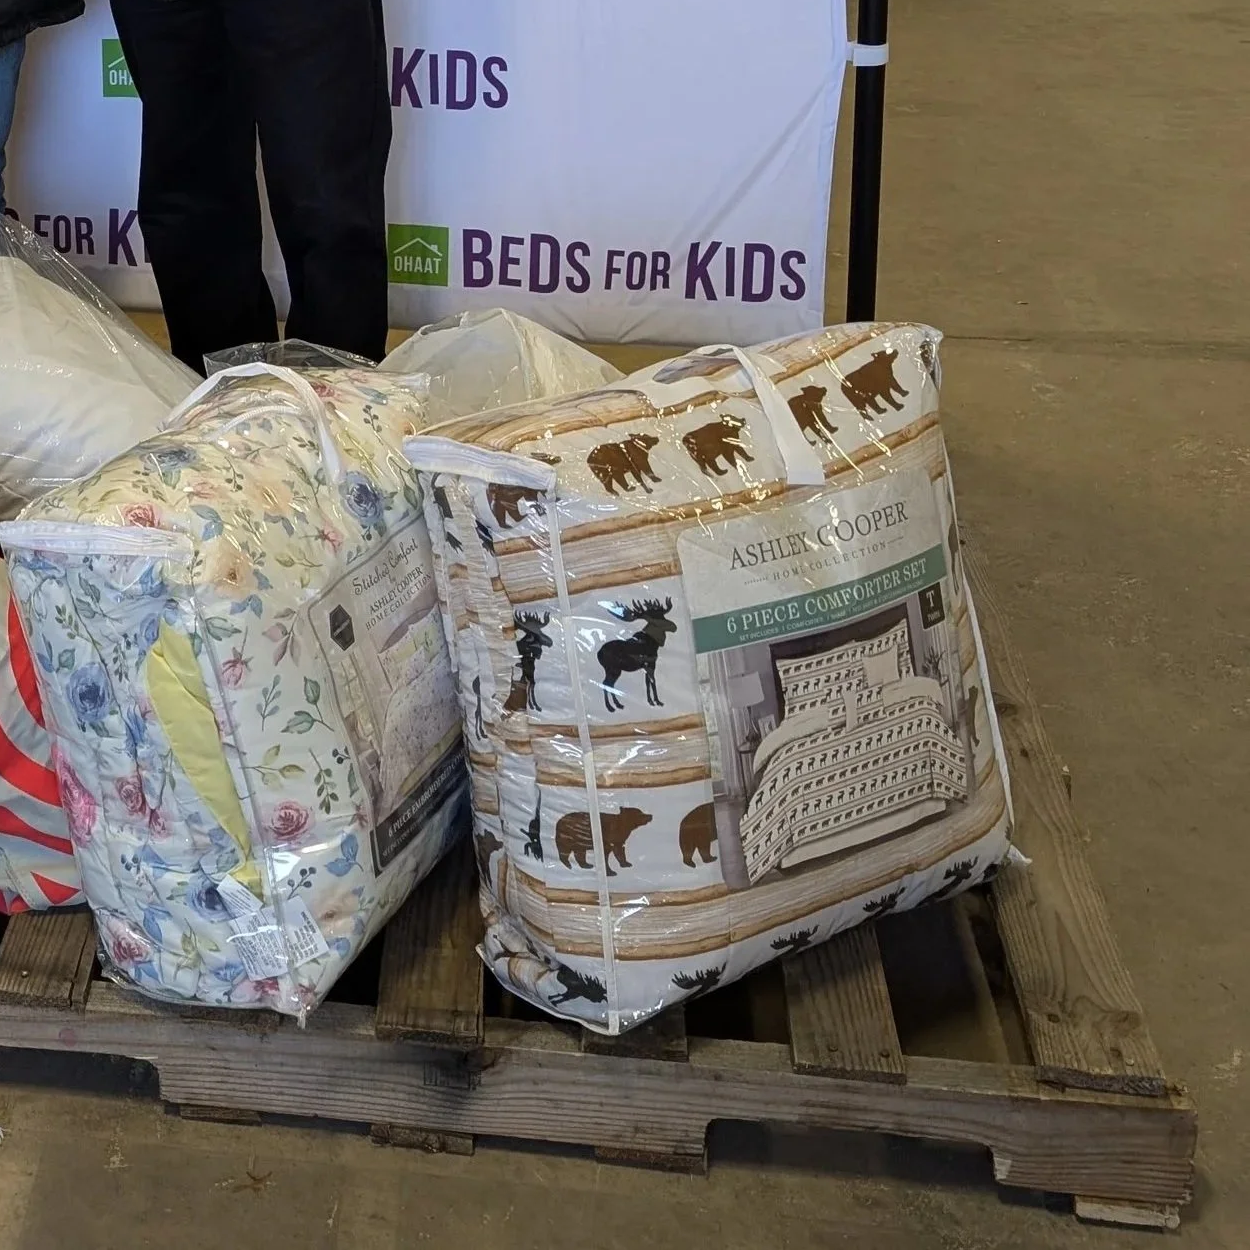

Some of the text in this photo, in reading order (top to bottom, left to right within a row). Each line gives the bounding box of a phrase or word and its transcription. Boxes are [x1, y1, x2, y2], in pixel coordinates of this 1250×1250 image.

[391, 46, 509, 111] KIDS
[34, 214, 95, 255] FOR
[396, 257, 441, 273] OHAAT
[463, 229, 805, 302] BEDS FOR KIDS
[729, 502, 908, 571] ASHLEY COOPER
[726, 557, 928, 634] 6 PIECE COMFORTER SET
[926, 590, 935, 608] T
